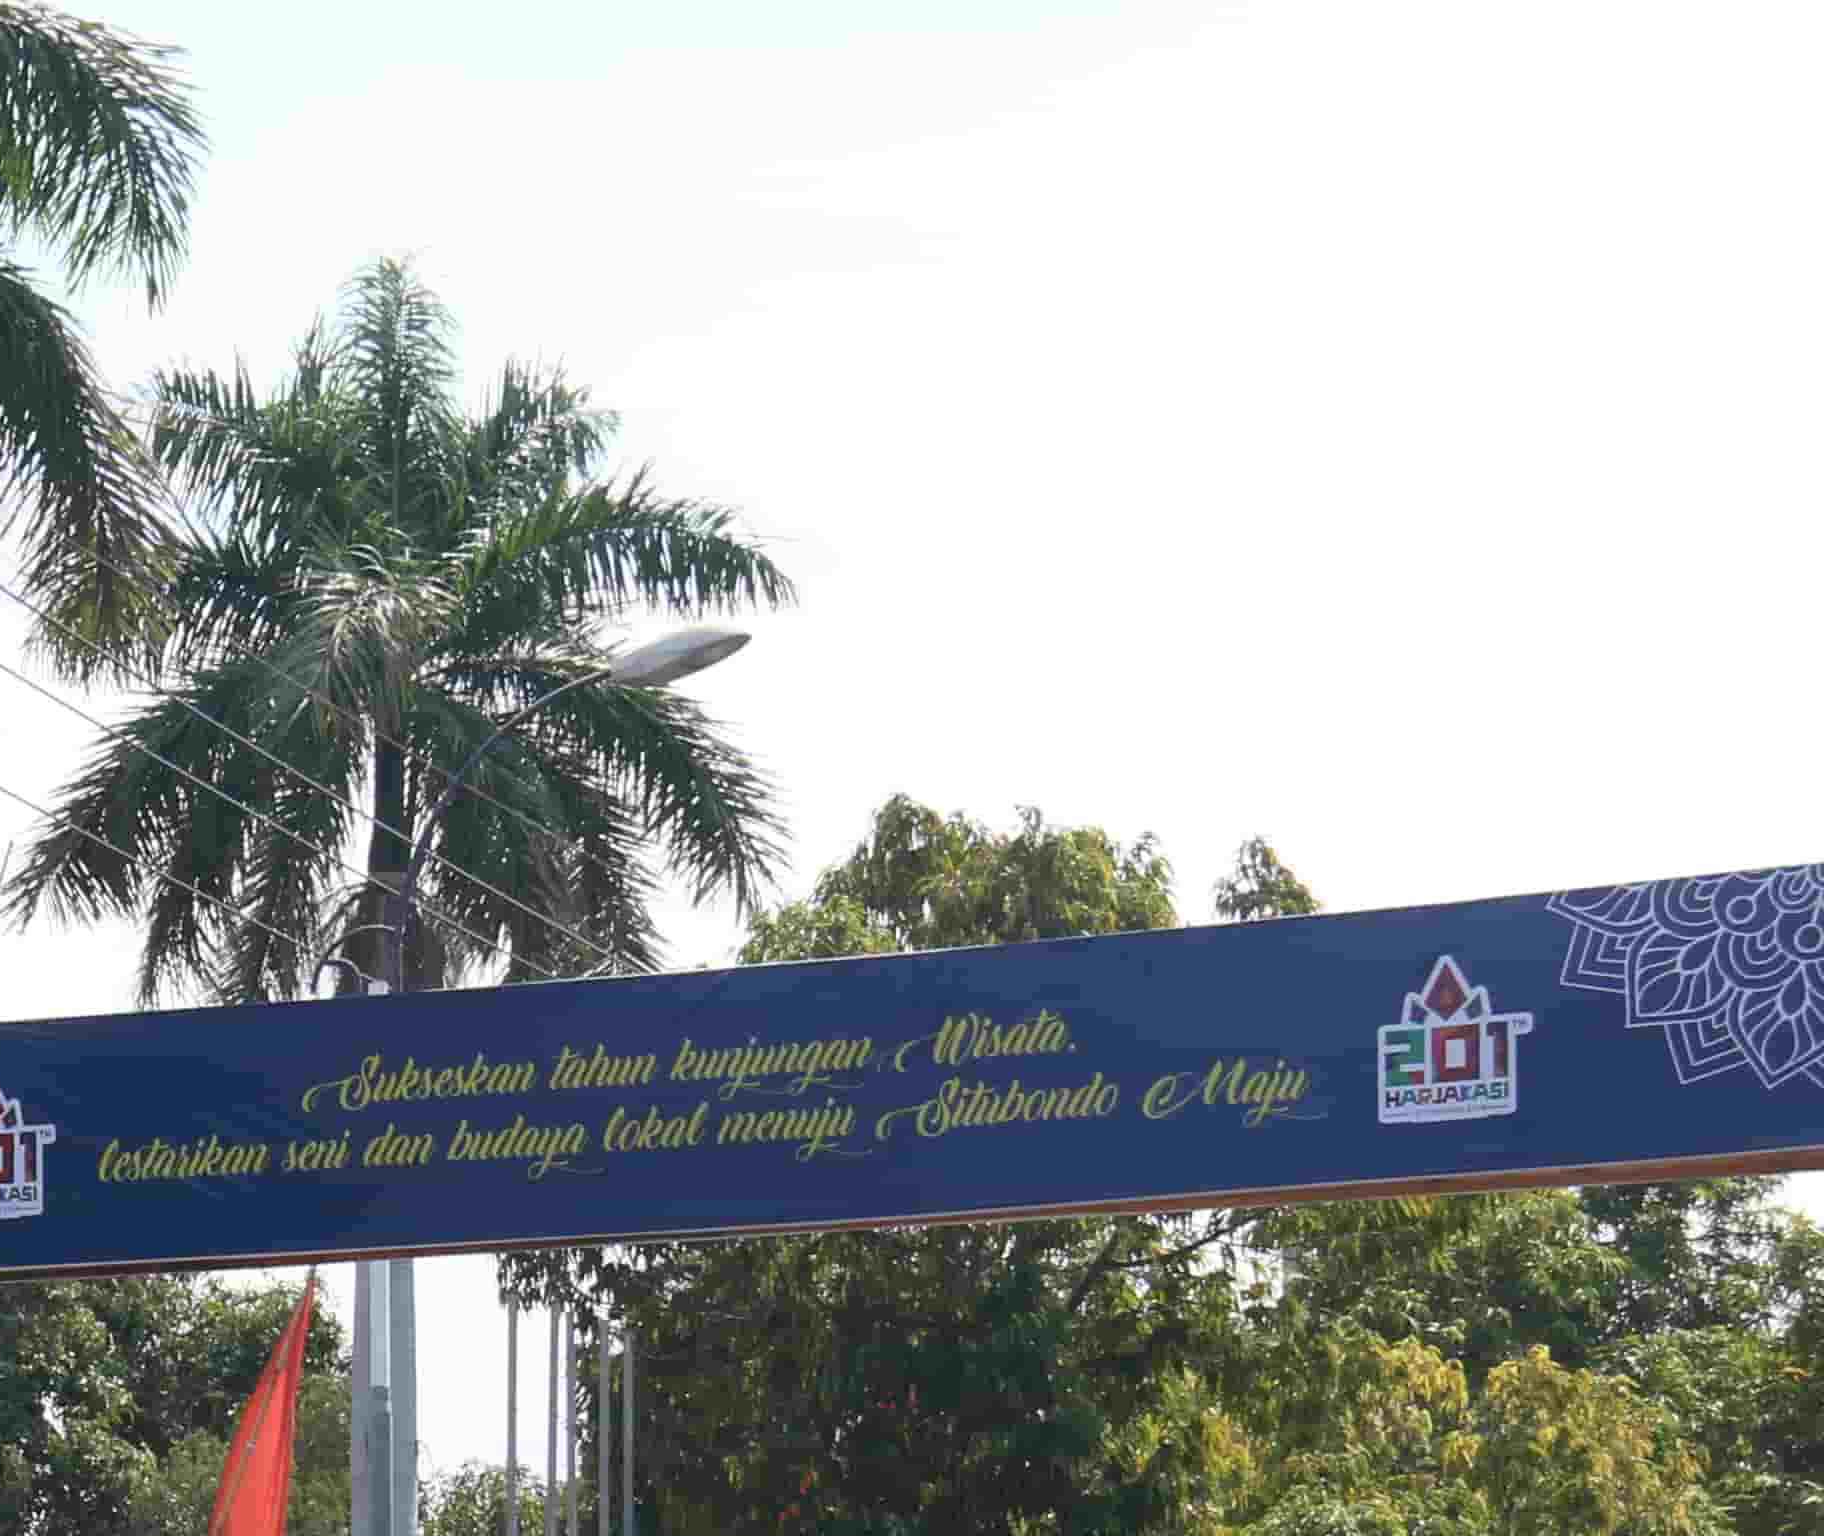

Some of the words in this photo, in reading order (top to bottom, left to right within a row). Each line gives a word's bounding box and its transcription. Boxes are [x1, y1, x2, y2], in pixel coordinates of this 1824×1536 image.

[280, 1130, 352, 1171] seni
[363, 1122, 434, 1168] dan
[445, 1115, 604, 1181] budaya
[604, 1102, 708, 1152] lokal
[717, 1097, 872, 1162] menuju
[875, 1074, 1120, 1140] Situbondo
[1141, 1057, 1330, 1127] Maju
[302, 1052, 536, 1112] Sukseskan
[550, 1043, 656, 1090] tahun
[670, 1035, 874, 1100] kunjungan
